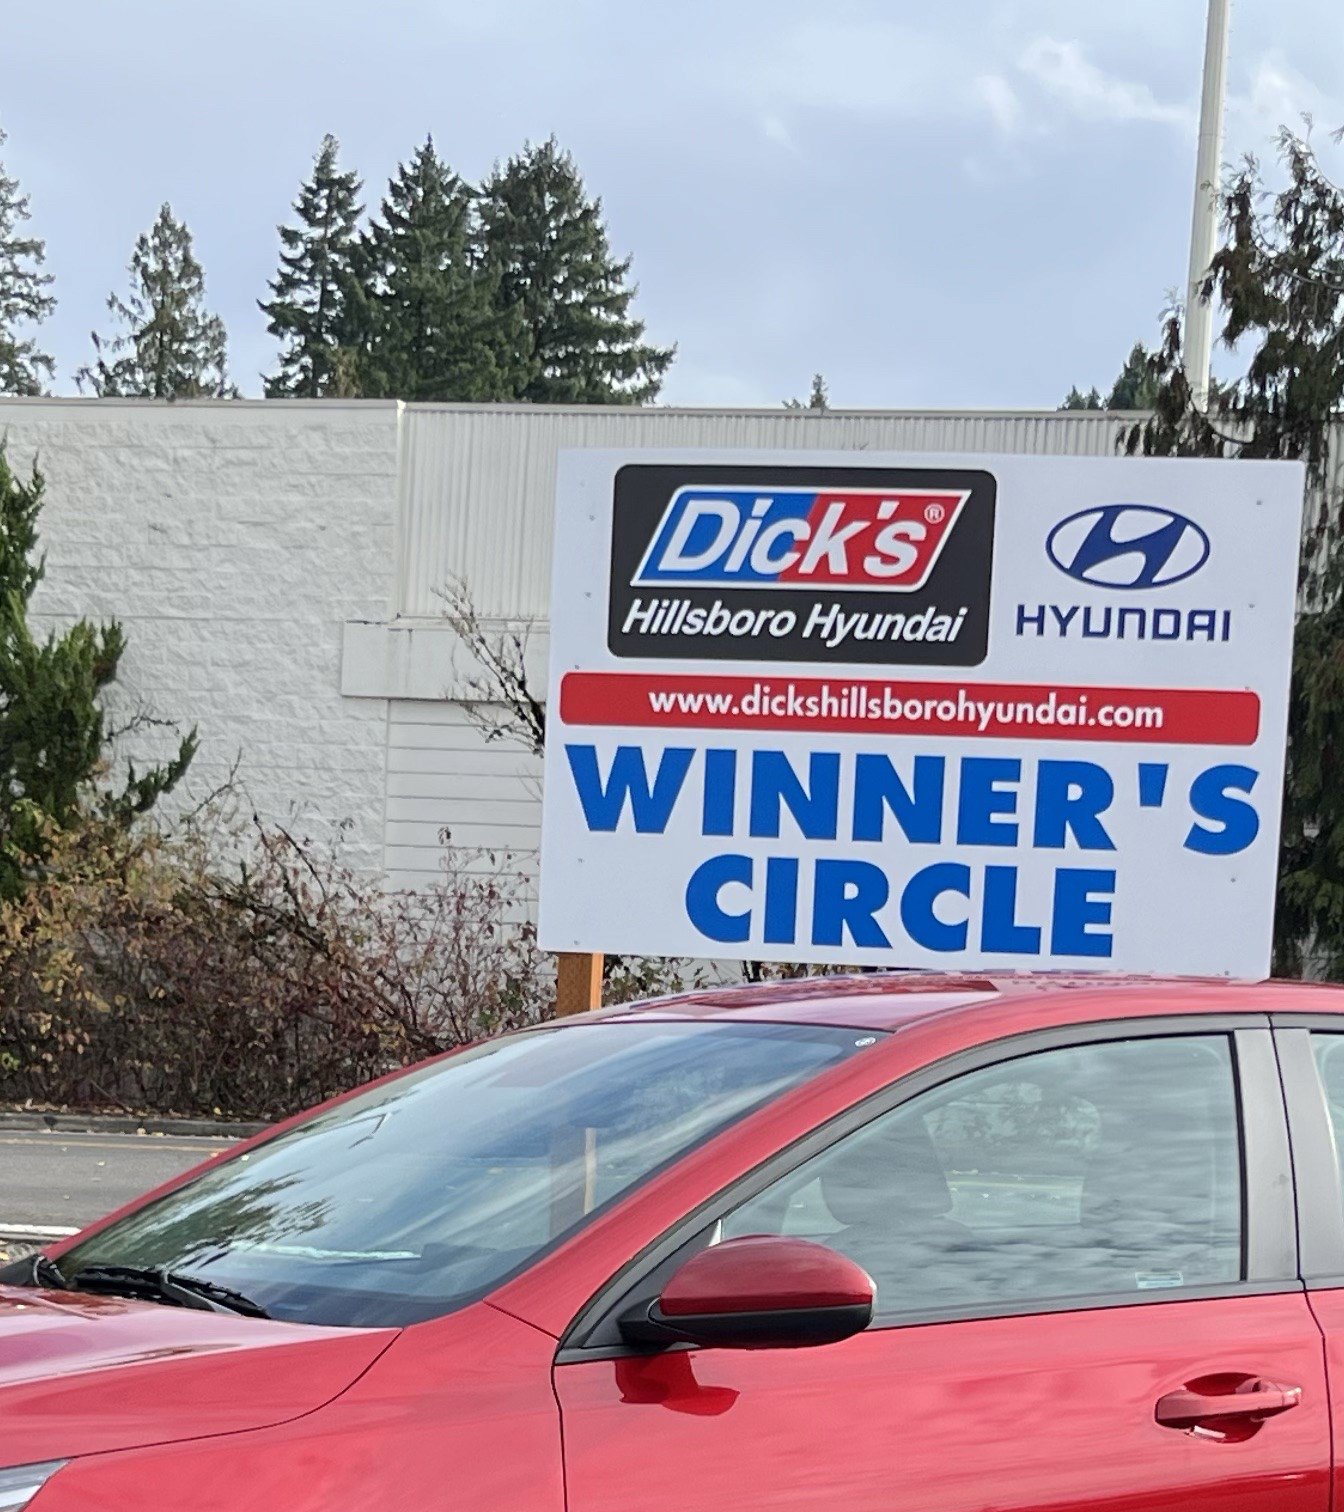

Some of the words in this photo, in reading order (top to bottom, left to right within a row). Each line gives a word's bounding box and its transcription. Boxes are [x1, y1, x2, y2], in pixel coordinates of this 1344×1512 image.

[656, 497, 927, 579] Dick's
[621, 599, 796, 639] Hillsboro
[804, 605, 969, 647] Hyundai
[1017, 604, 1230, 642] HYUNDAI
[648, 684, 1165, 731] www.dickshillsborohyundai.com
[565, 743, 1260, 857] WINNER'S
[685, 854, 1117, 957] CIRCLE
